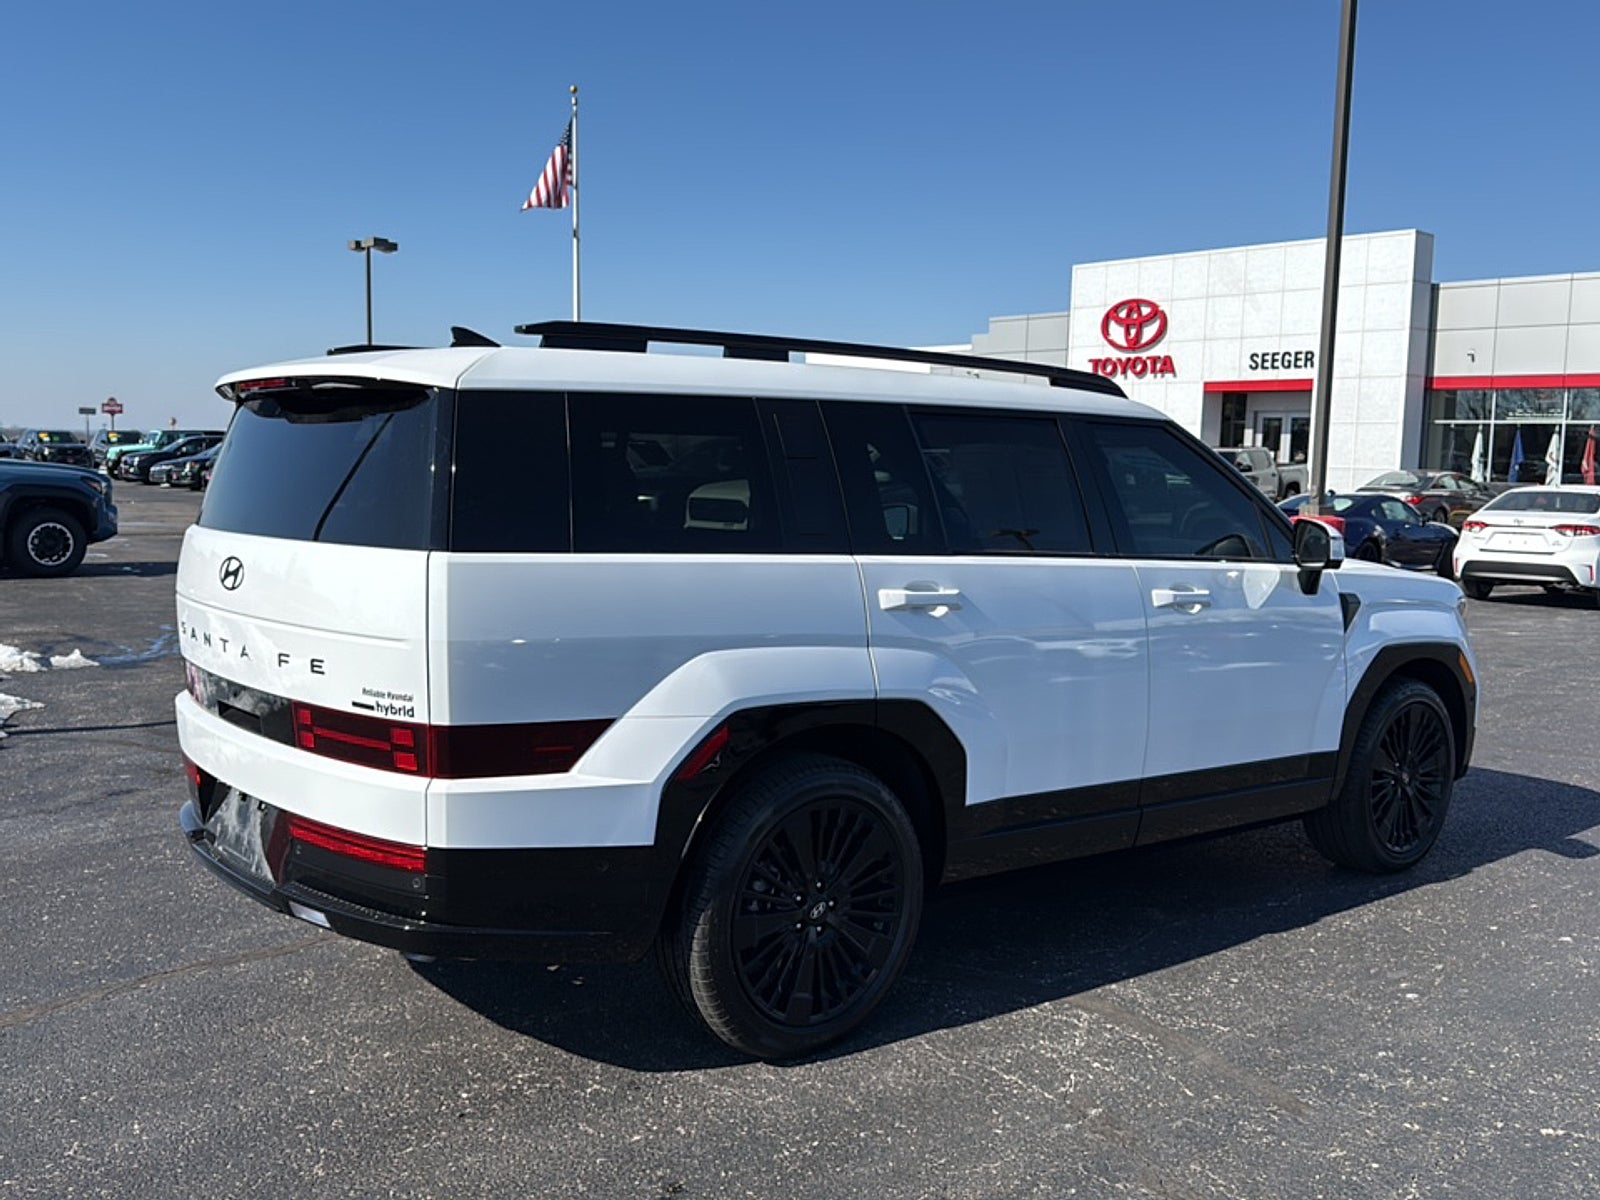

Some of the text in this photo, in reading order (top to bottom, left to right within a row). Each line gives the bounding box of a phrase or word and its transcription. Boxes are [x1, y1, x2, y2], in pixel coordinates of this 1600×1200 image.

[1088, 355, 1176, 378] TOYOTA
[1248, 350, 1315, 371] SEEGER
[181, 621, 326, 676] SANTA FE
[375, 700, 415, 718] hybrid
